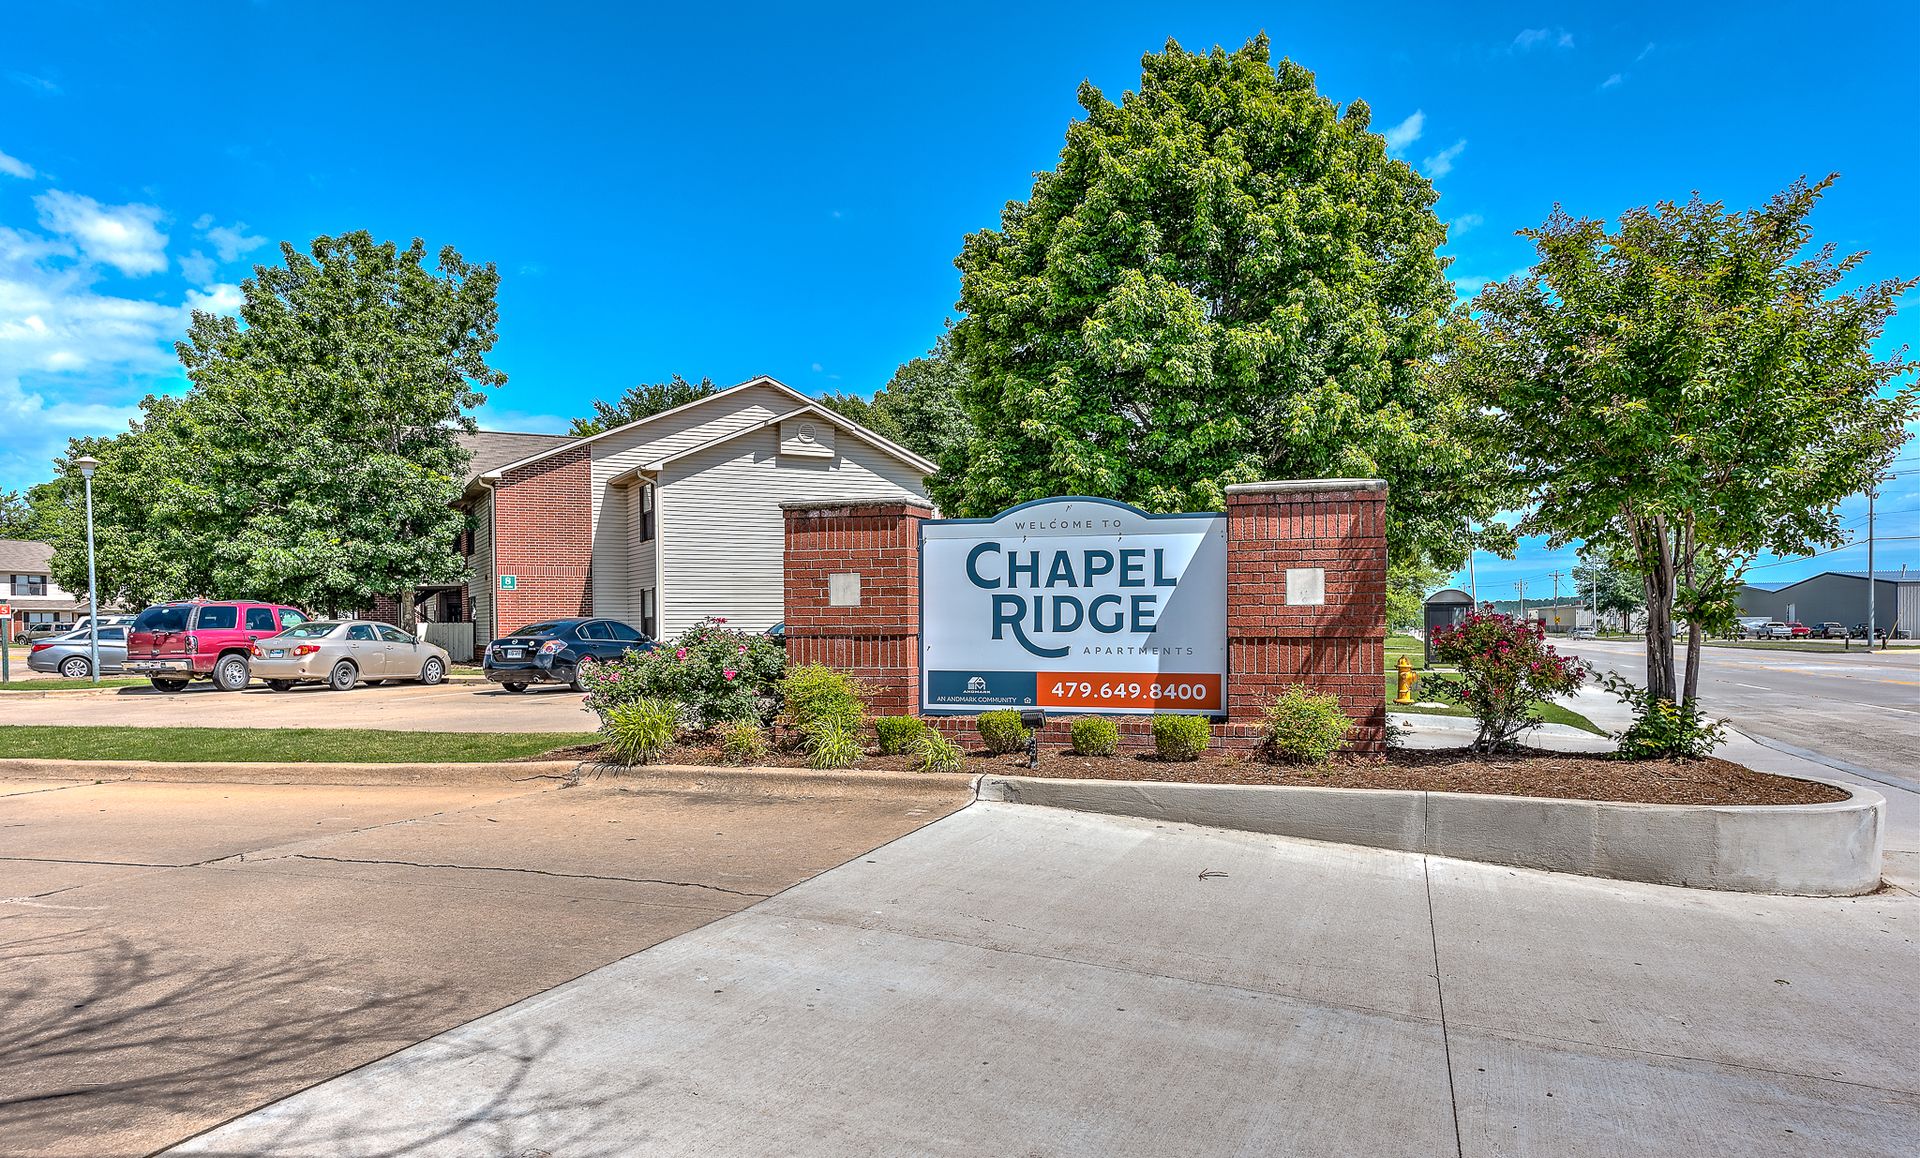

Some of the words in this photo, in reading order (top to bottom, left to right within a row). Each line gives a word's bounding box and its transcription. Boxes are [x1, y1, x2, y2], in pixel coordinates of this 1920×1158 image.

[1015, 520, 1092, 530] WELCOME
[1102, 519, 1121, 528] TO
[966, 541, 1177, 589] CHAPEL
[991, 594, 1157, 658] RIDGE
[1083, 646, 1194, 656] APARTMENTS
[1051, 682, 1207, 700] 479.649.8400
